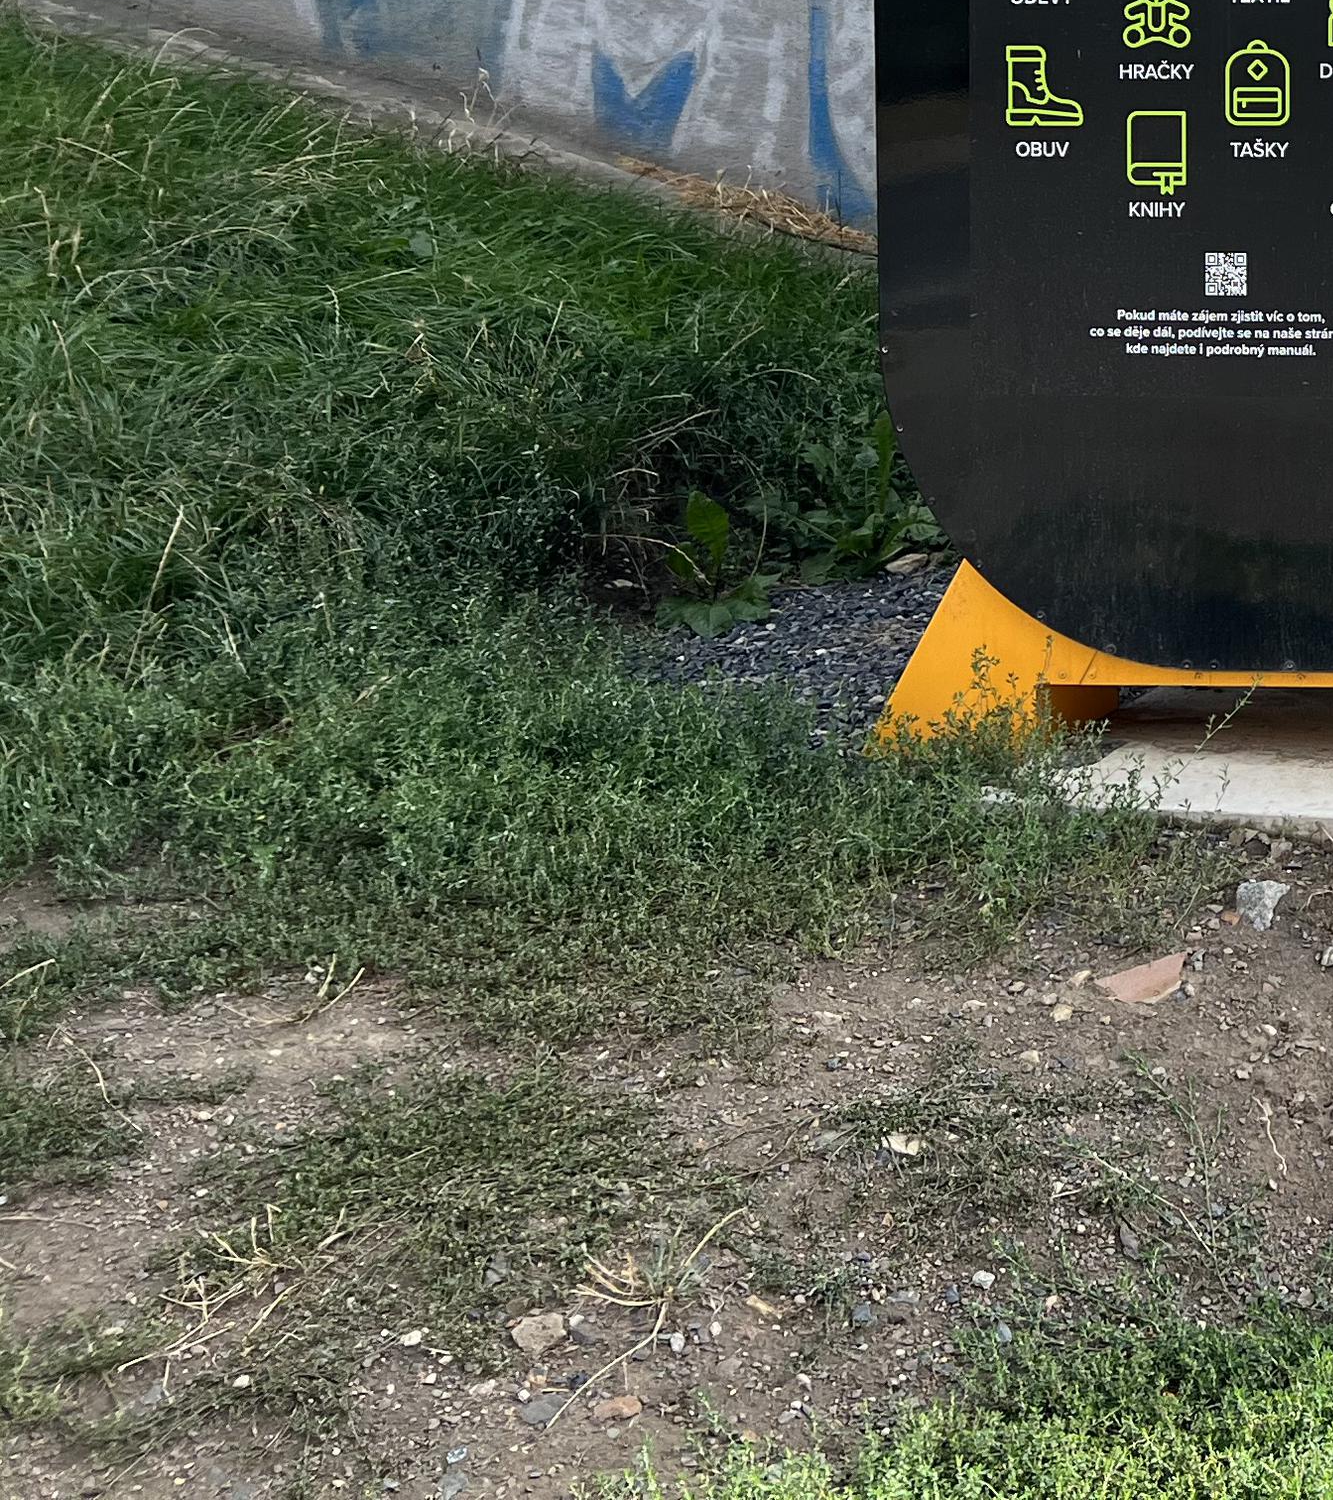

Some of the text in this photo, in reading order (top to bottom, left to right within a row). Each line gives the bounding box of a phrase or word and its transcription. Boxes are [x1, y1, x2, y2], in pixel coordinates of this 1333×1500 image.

[1119, 58, 1194, 80] HRAČKY
[1015, 141, 1069, 158] OBUV
[1230, 137, 1289, 158] TAŠKY
[1128, 201, 1186, 218] KNIHY
[1117, 309, 1326, 326] Pokud máte zájem zjistit víc o tom,
[1089, 328, 1105, 339] co
[1107, 328, 1122, 339] se
[1124, 325, 1150, 342] děje
[1153, 326, 1176, 342] dál,
[1178, 325, 1235, 343] podívejte
[1237, 328, 1252, 340] se
[1254, 329, 1270, 340] na
[1272, 326, 1303, 340] naše
[1125, 343, 1317, 359] kde najdete i podrobný manuál.
